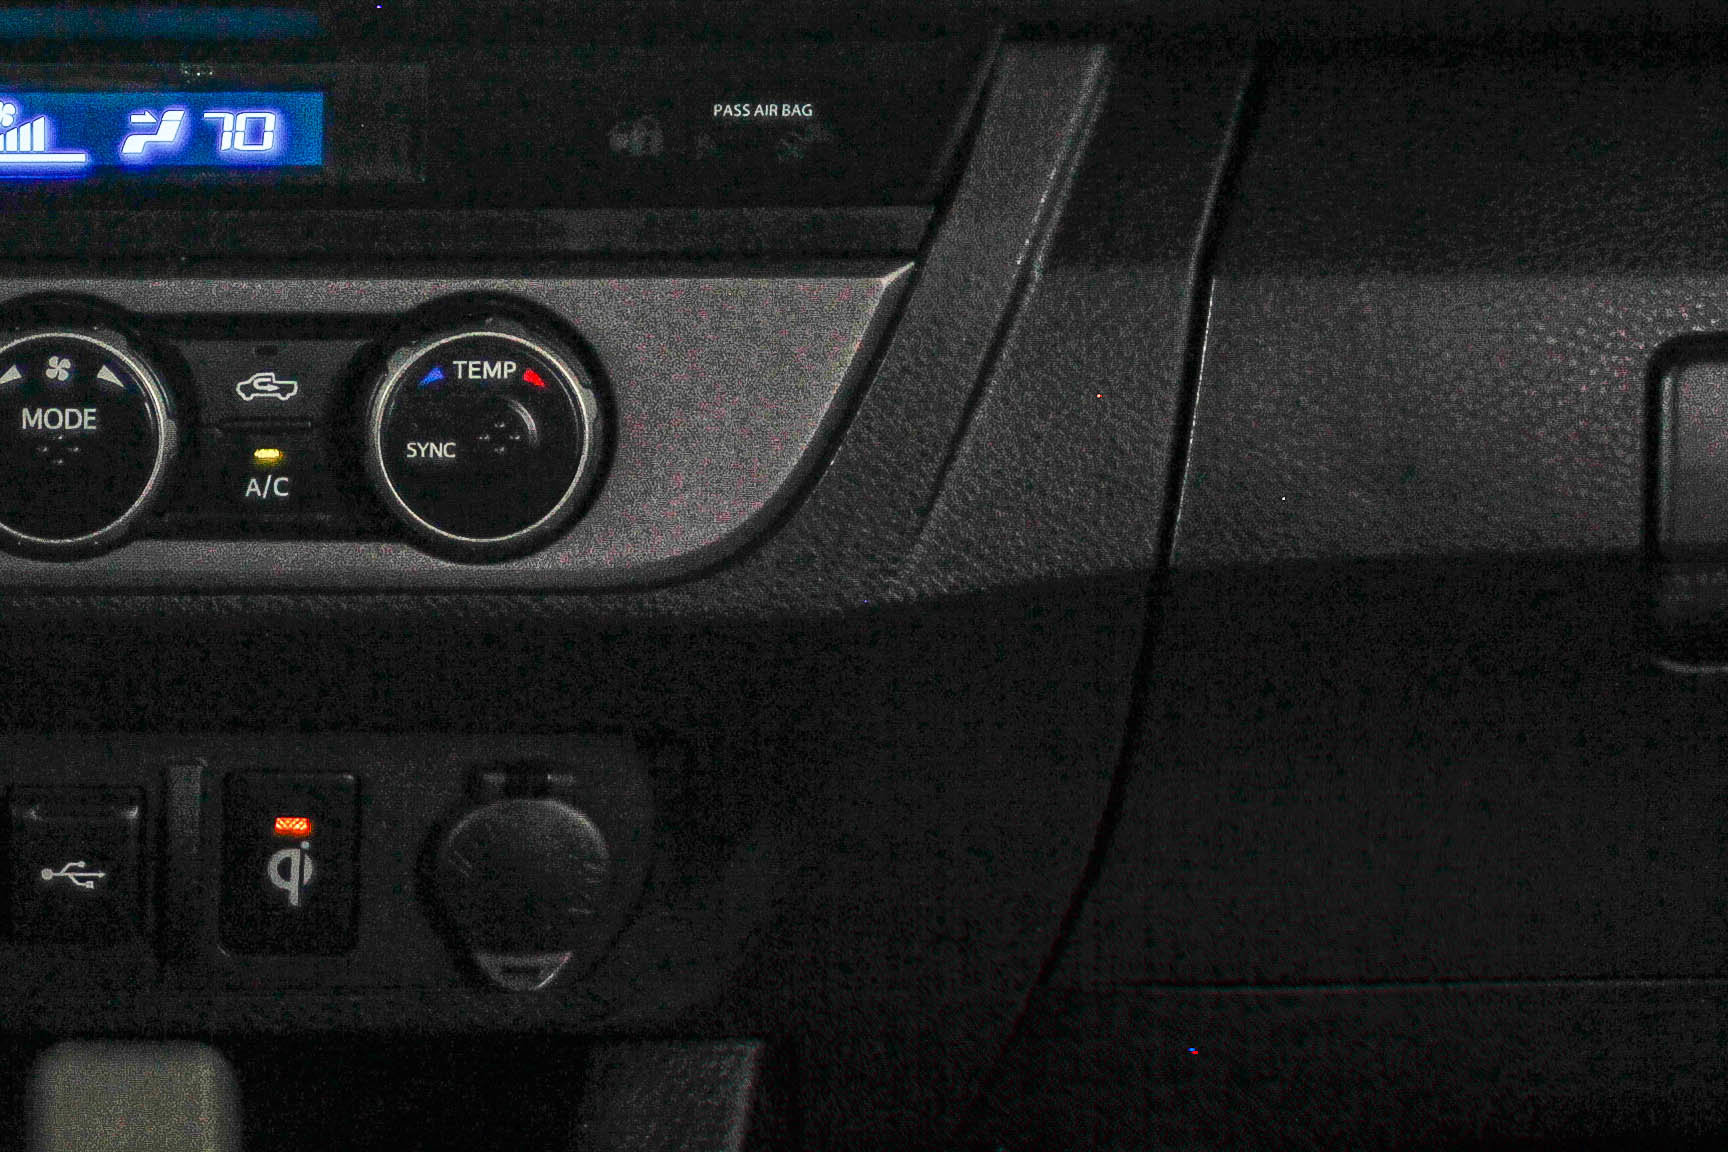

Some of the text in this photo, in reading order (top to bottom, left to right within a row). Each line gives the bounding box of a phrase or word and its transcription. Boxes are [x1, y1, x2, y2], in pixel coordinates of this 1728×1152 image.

[713, 103, 814, 118] PASS AIR BAG
[203, 110, 276, 152] 70
[452, 360, 517, 380] TEMP
[21, 407, 97, 430] MODE
[406, 441, 456, 459] SYNC
[245, 474, 289, 499] A/C
